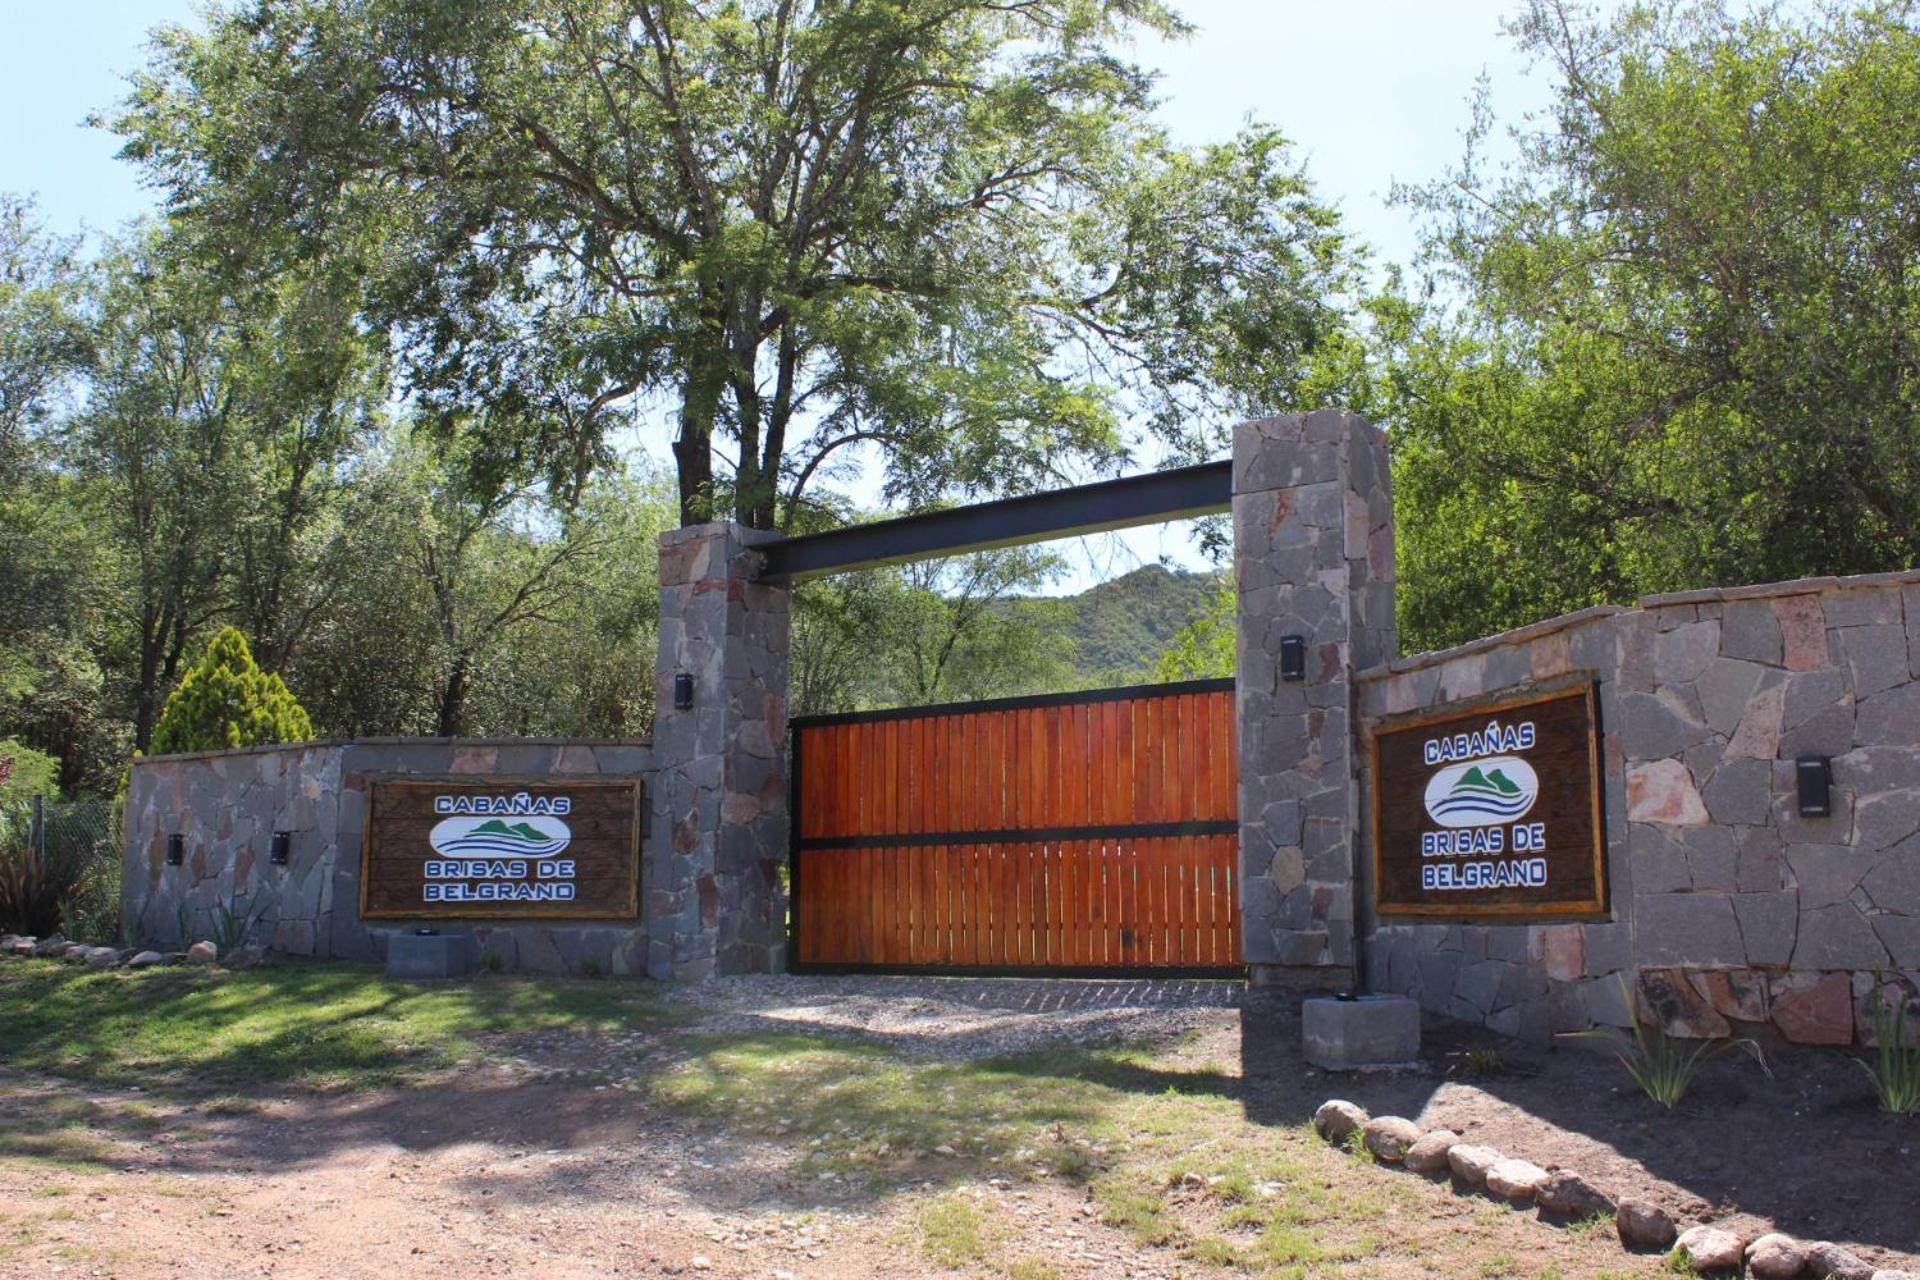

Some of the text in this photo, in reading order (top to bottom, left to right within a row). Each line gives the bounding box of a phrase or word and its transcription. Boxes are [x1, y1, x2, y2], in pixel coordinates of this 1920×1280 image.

[1425, 722, 1534, 763] CABAÑAS
[436, 793, 570, 813] CABAÑAS
[1423, 824, 1544, 855] BRISAS DE
[426, 861, 575, 878] BRISAS DE
[1423, 859, 1546, 888] BELGRANO
[425, 884, 575, 900] BELGRANO
